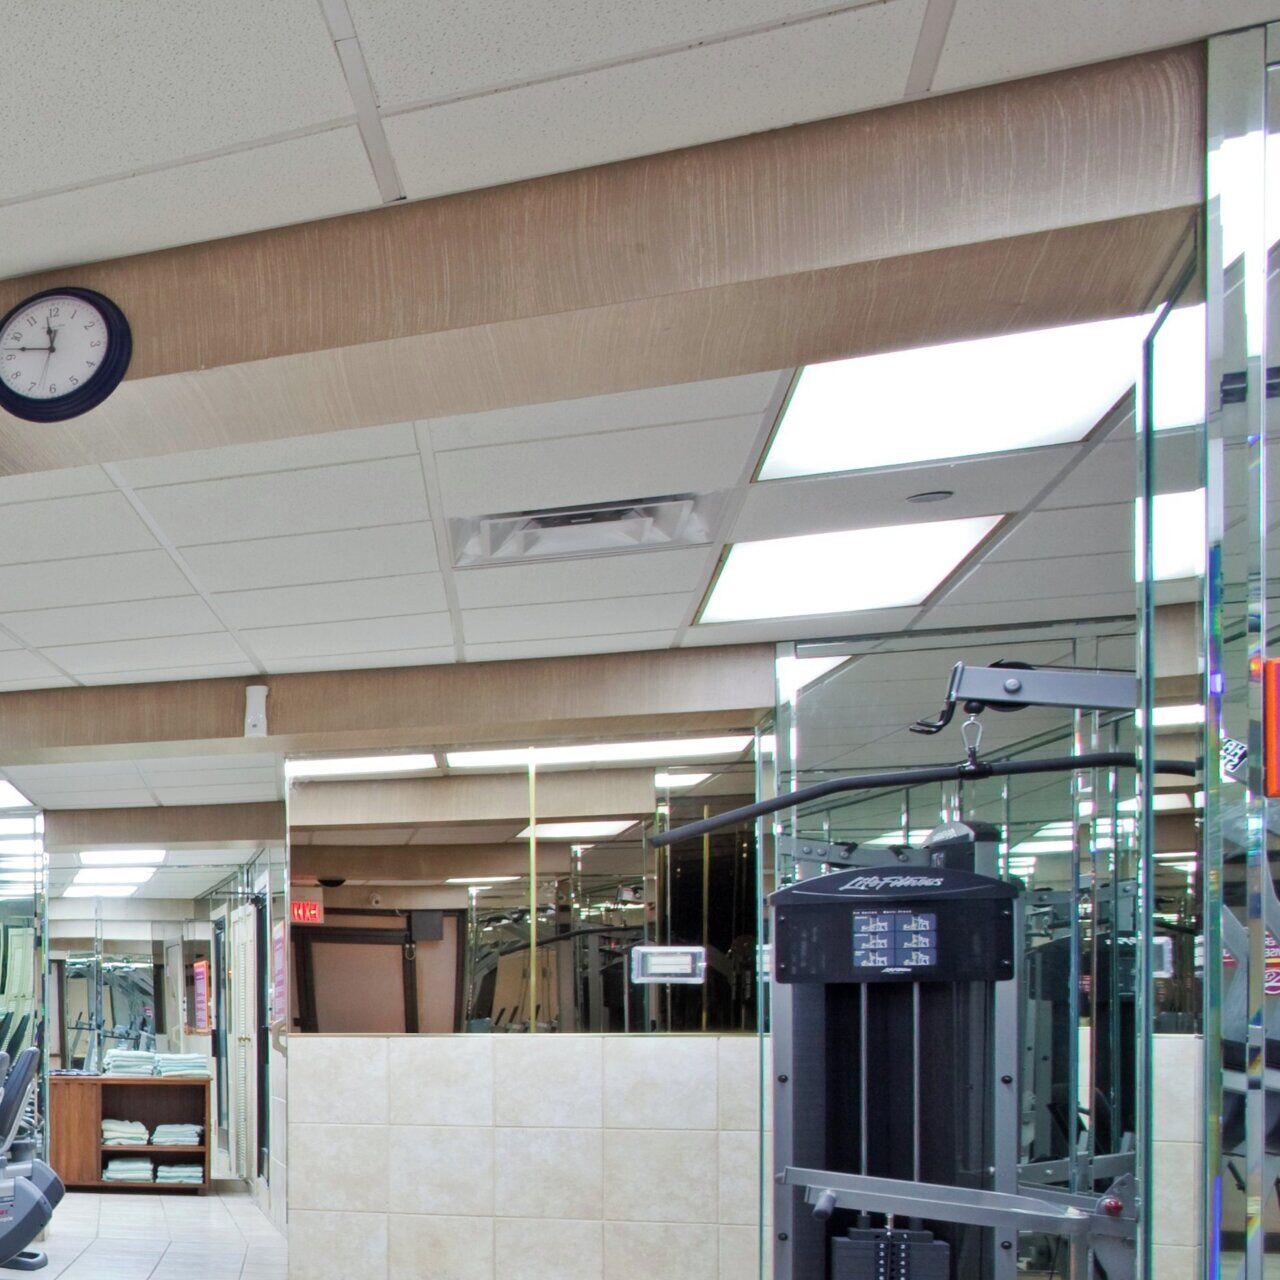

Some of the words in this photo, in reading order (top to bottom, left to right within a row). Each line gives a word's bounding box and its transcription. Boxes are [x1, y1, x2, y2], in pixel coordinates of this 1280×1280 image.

[49, 307, 60, 318] 12
[27, 316, 37, 327] 11
[84, 321, 95, 330] 2
[11, 332, 23, 342] 10
[90, 340, 100, 348] 3
[86, 360, 96, 368] 4
[11, 371, 21, 380] 8
[69, 375, 79, 386] 5
[27, 382, 36, 392] 7
[49, 384, 56, 393] 6
